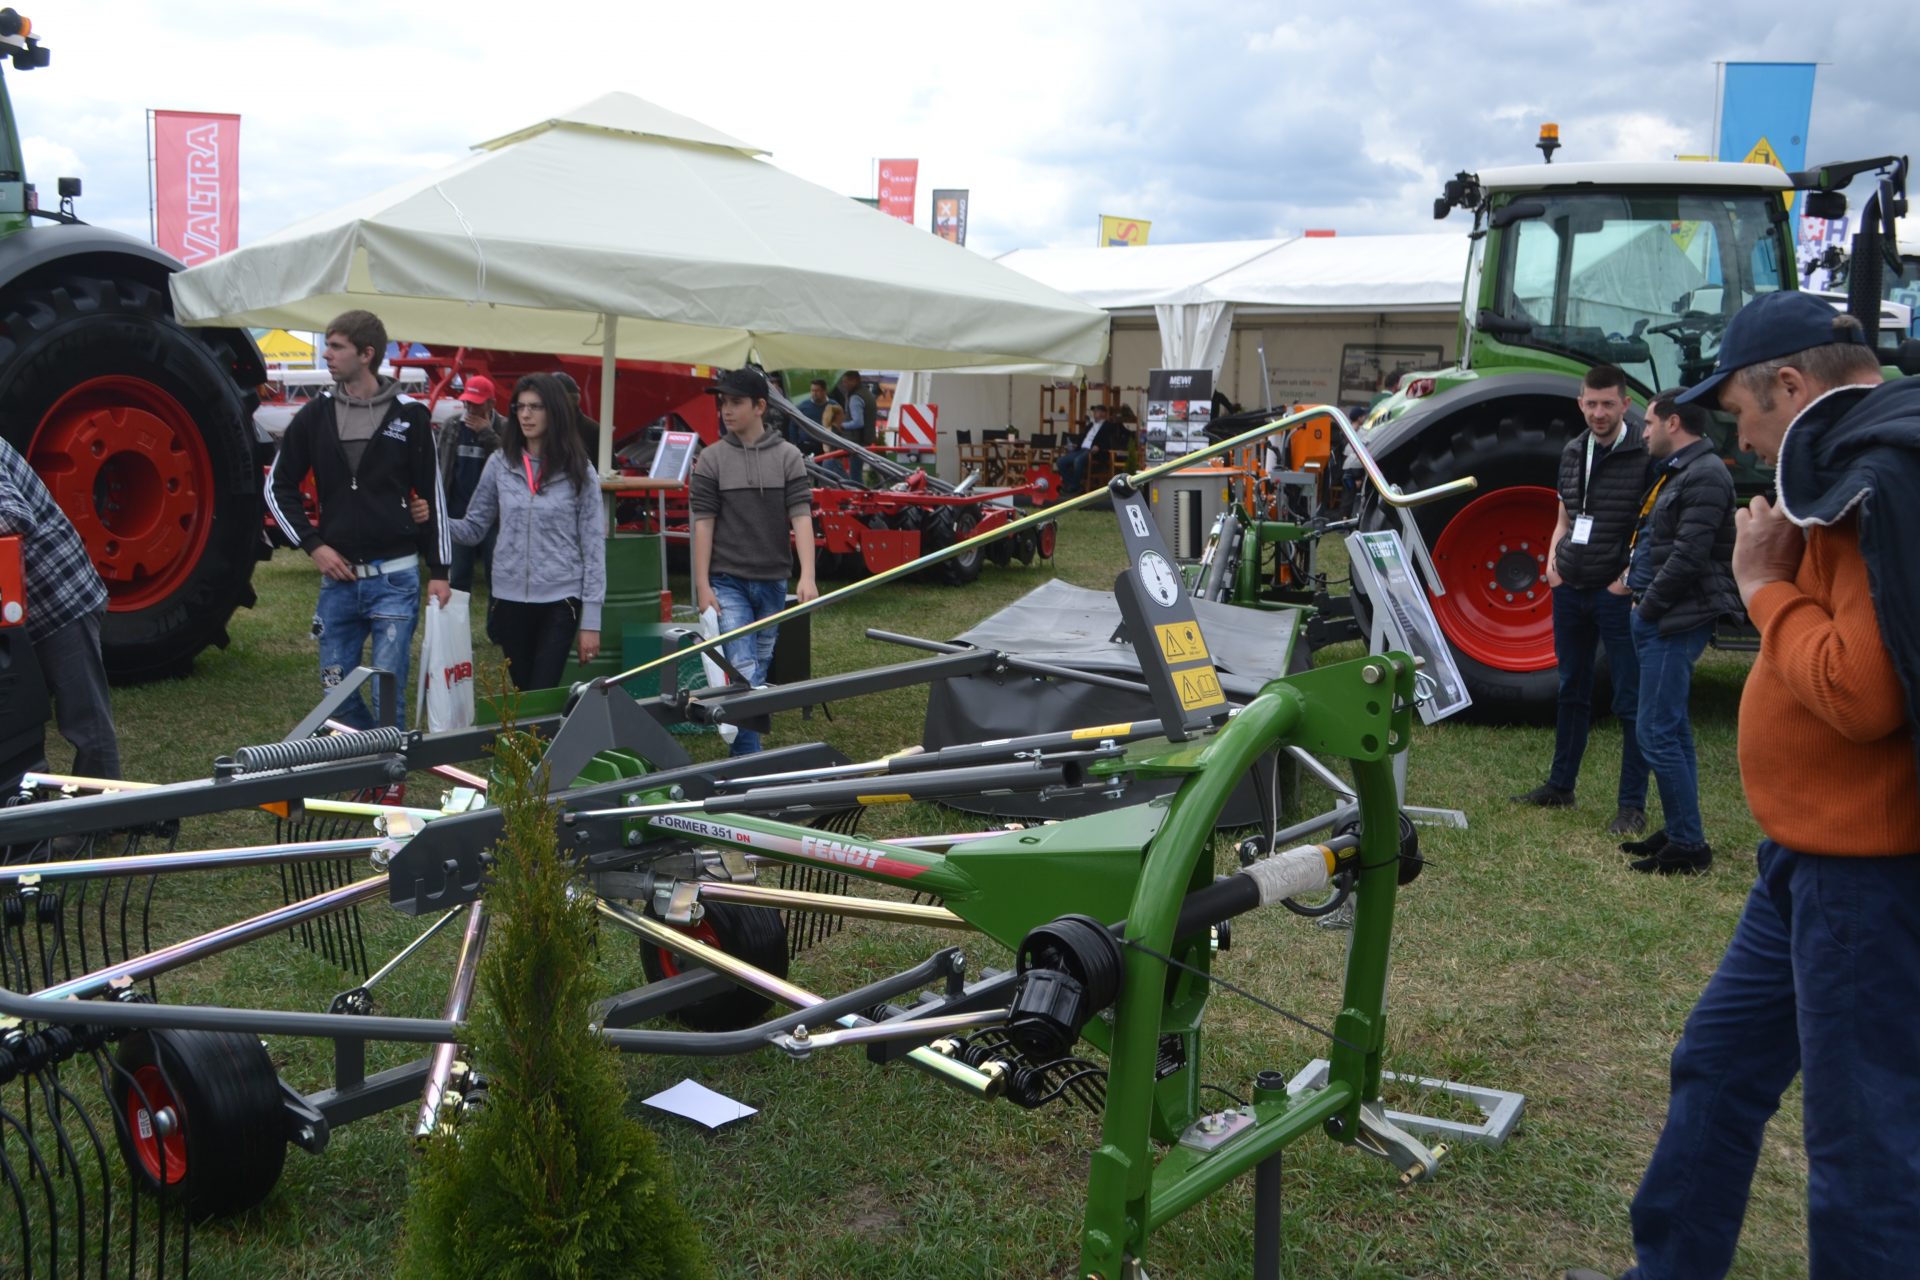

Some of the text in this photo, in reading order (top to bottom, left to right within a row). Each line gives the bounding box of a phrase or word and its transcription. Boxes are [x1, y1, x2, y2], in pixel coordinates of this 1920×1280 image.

[183, 122, 219, 267] VALTRA
[658, 815, 750, 843] FORMER 351 DN
[801, 835, 888, 869] FENDT
